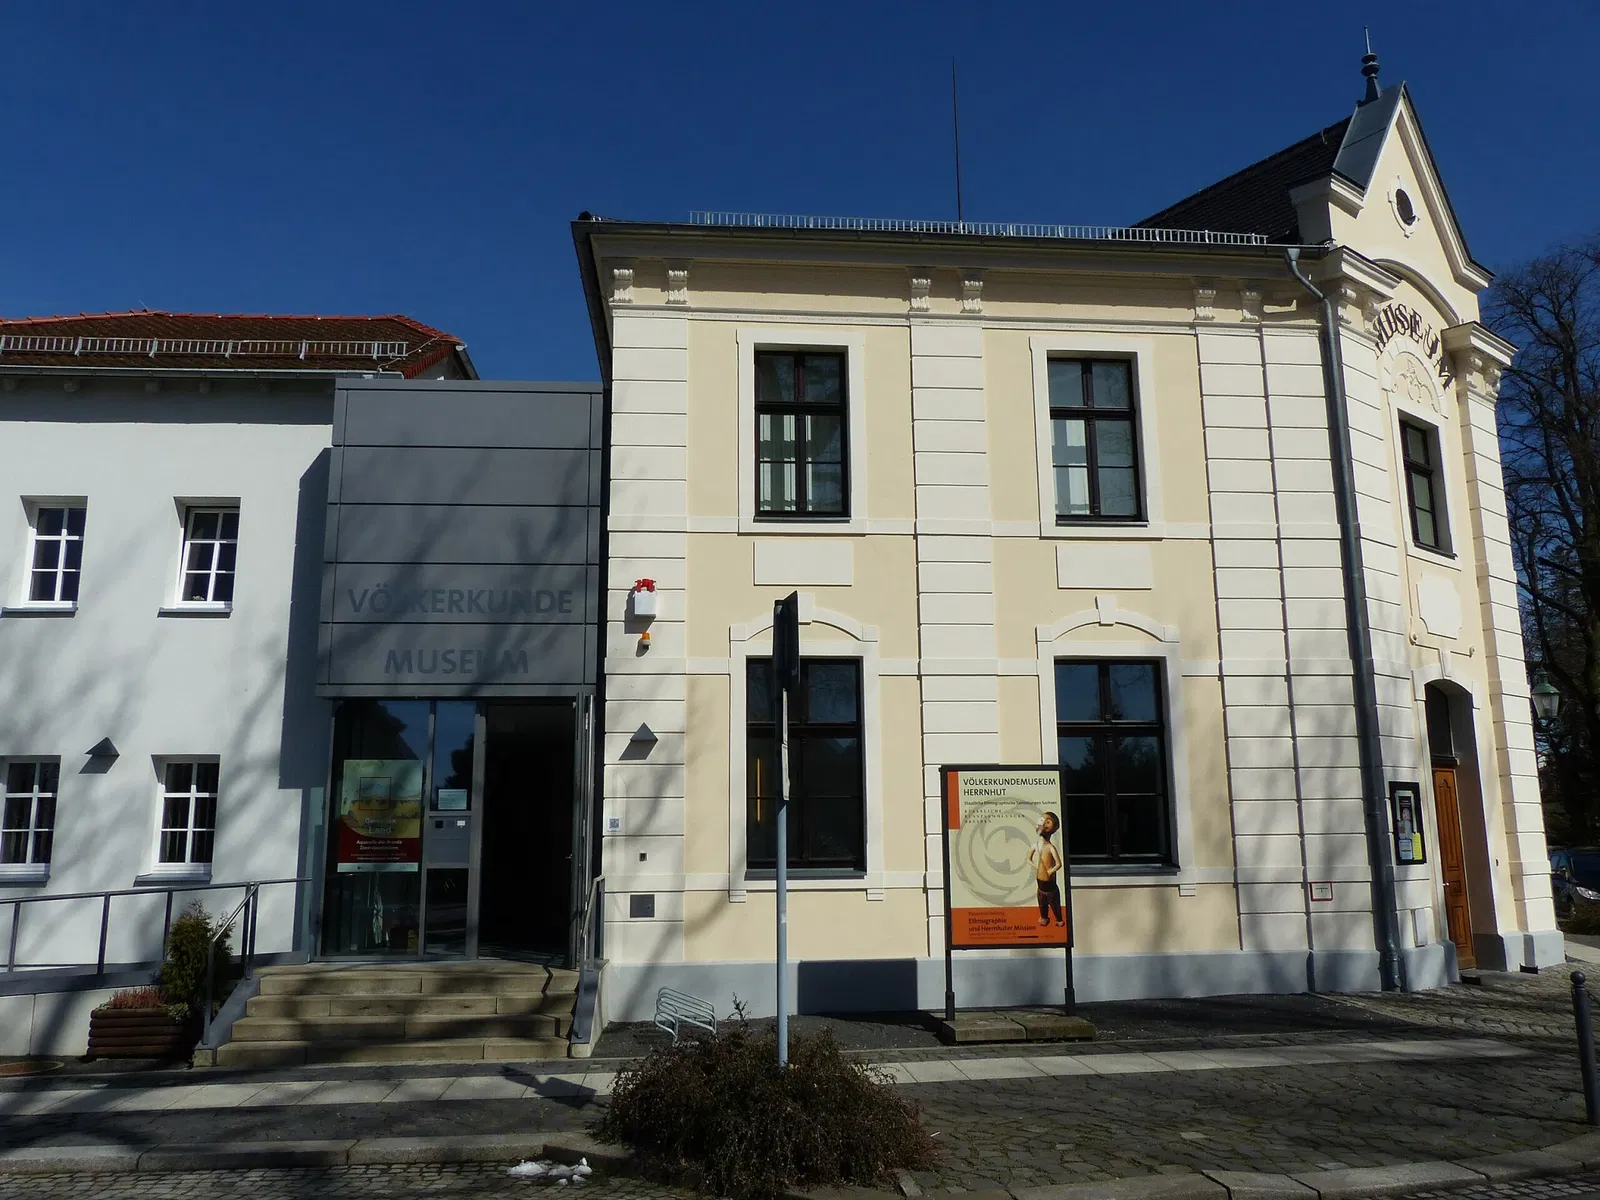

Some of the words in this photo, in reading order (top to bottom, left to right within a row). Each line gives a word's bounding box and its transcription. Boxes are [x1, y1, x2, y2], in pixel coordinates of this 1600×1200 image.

[1374, 303, 1458, 391] MUSEUM
[348, 582, 573, 614] VÖLKERKUNDE
[384, 648, 529, 674] MUSEUM
[963, 777, 1057, 786] VÖLKERKUNDEMUSEUM
[963, 788, 1007, 796] HERRNHUT
[968, 917, 1007, 925] Ethnographie
